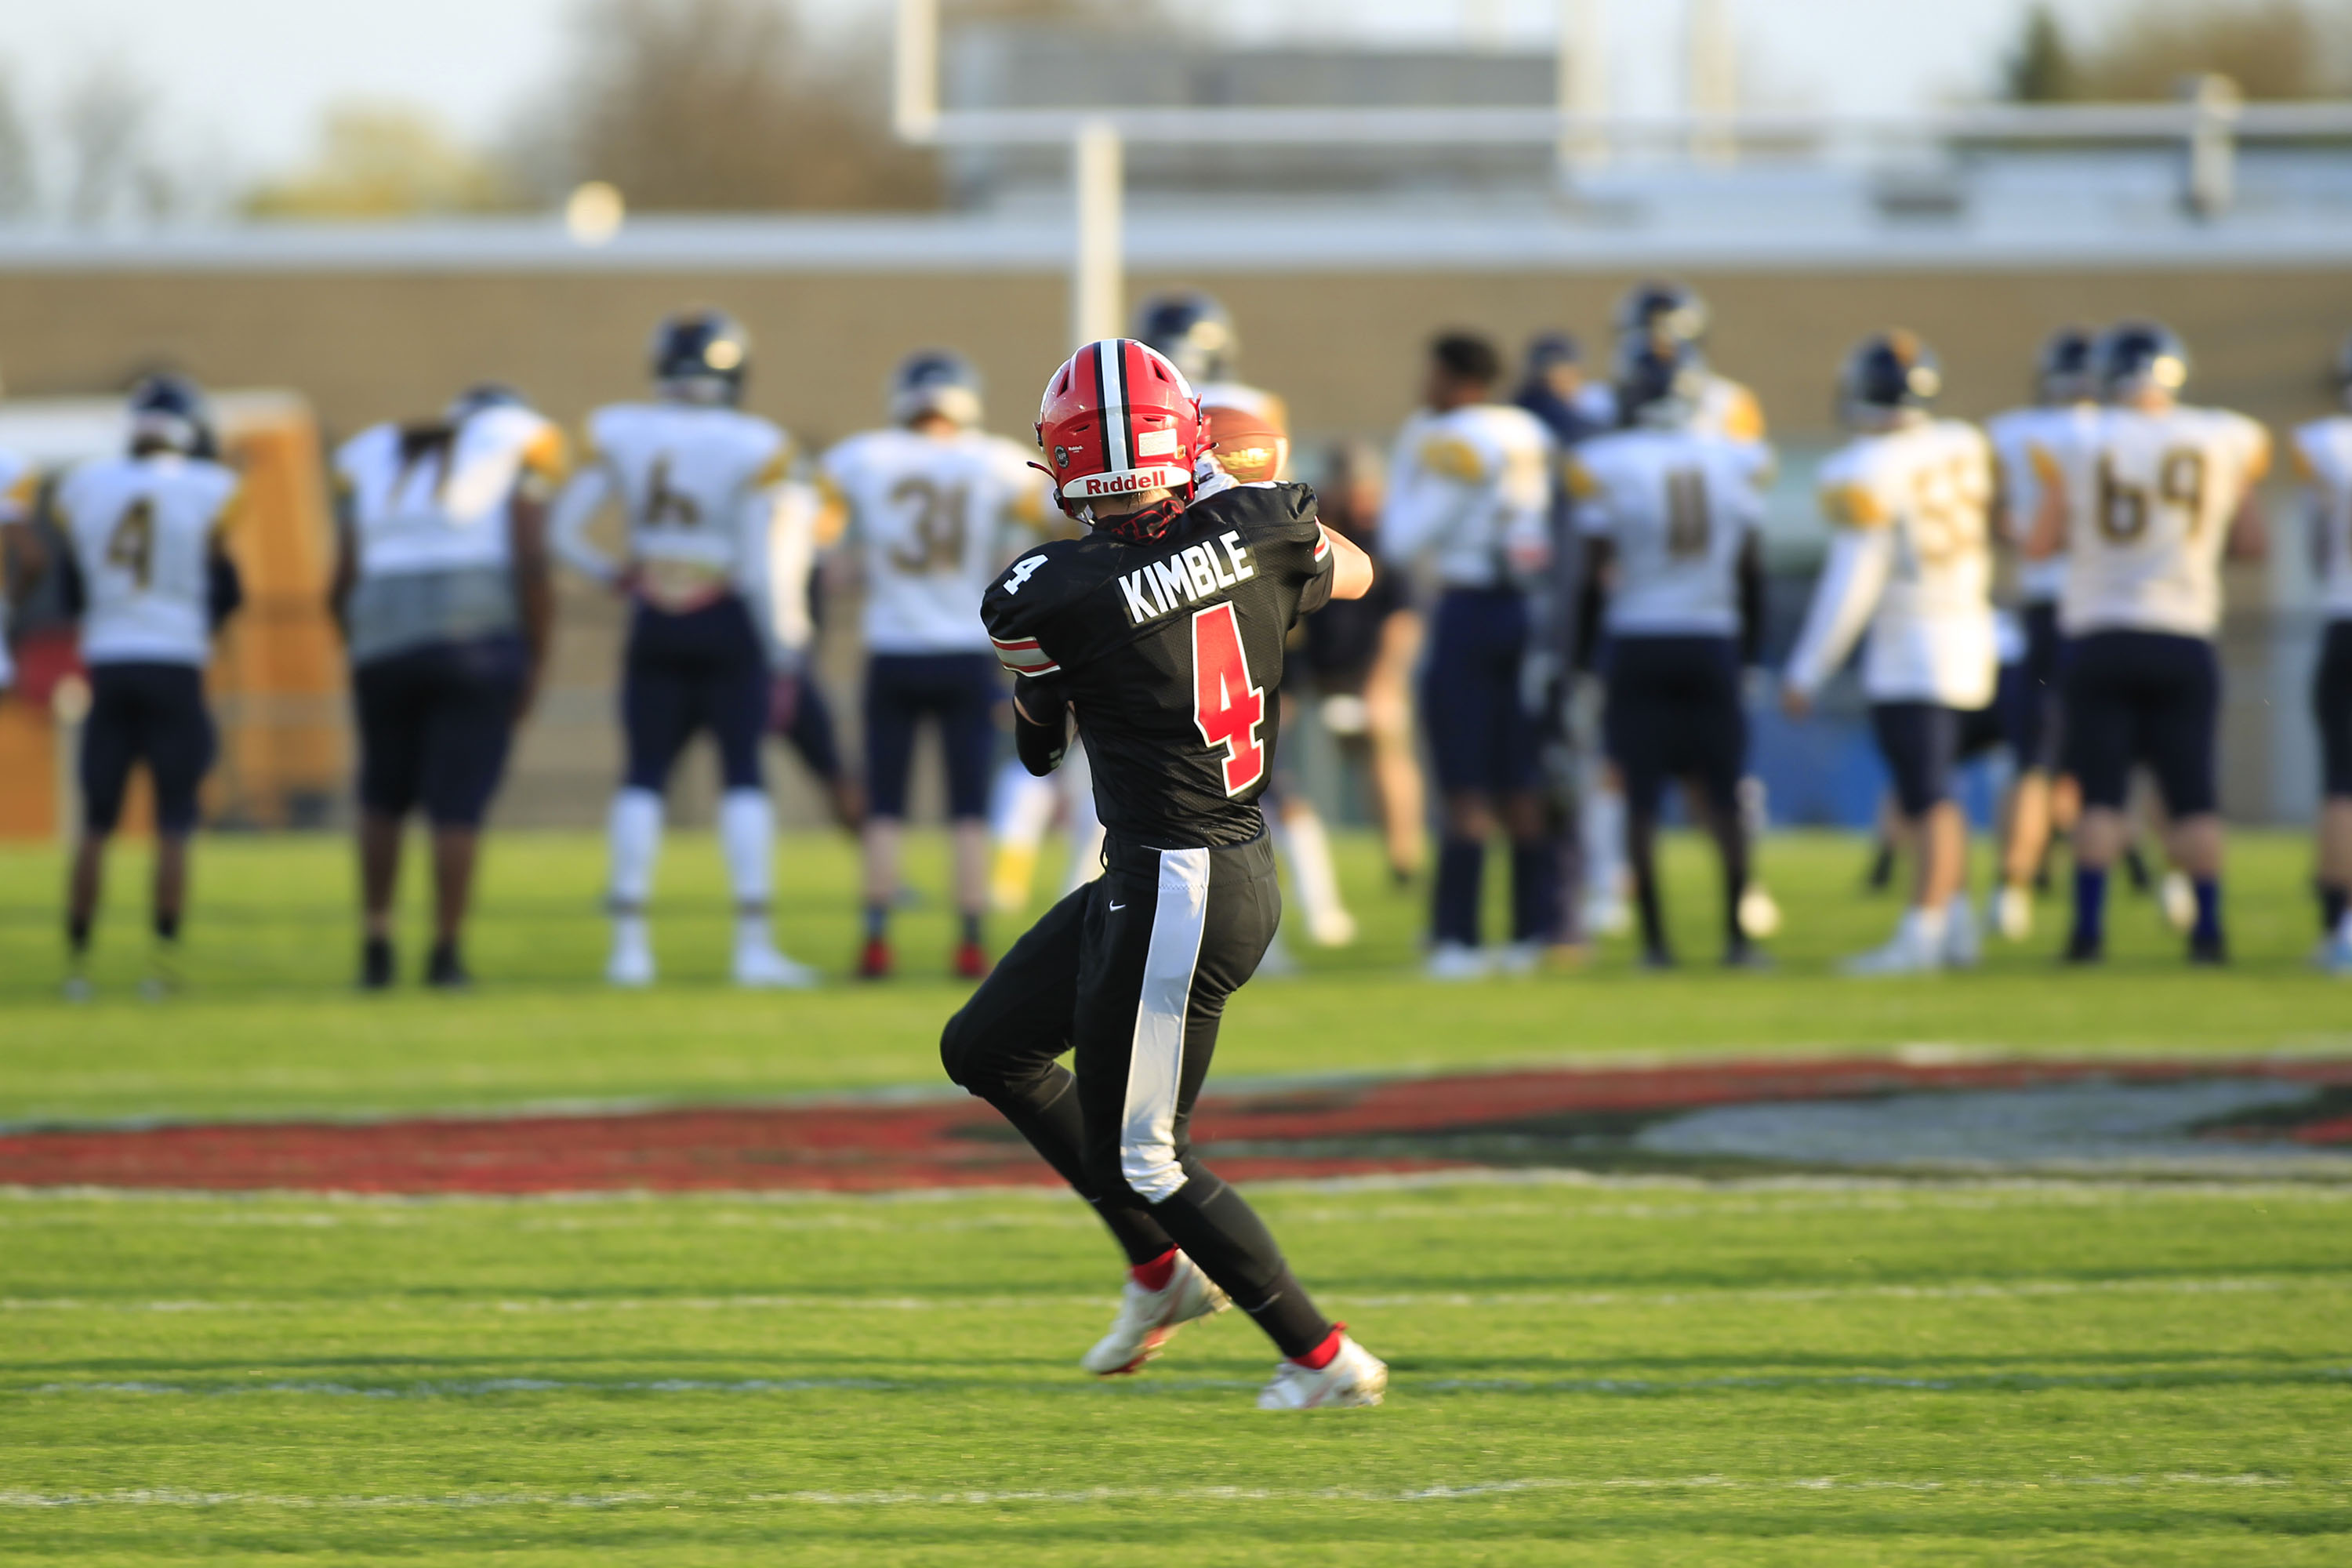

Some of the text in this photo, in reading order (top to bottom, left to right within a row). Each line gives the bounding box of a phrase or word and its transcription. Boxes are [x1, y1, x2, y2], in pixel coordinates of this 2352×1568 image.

[1086, 470, 1166, 495] Riddell
[105, 492, 157, 590] 4
[1003, 554, 1049, 595] 4
[1118, 530, 1254, 624] KIMBLE
[1192, 601, 1265, 797] 4
